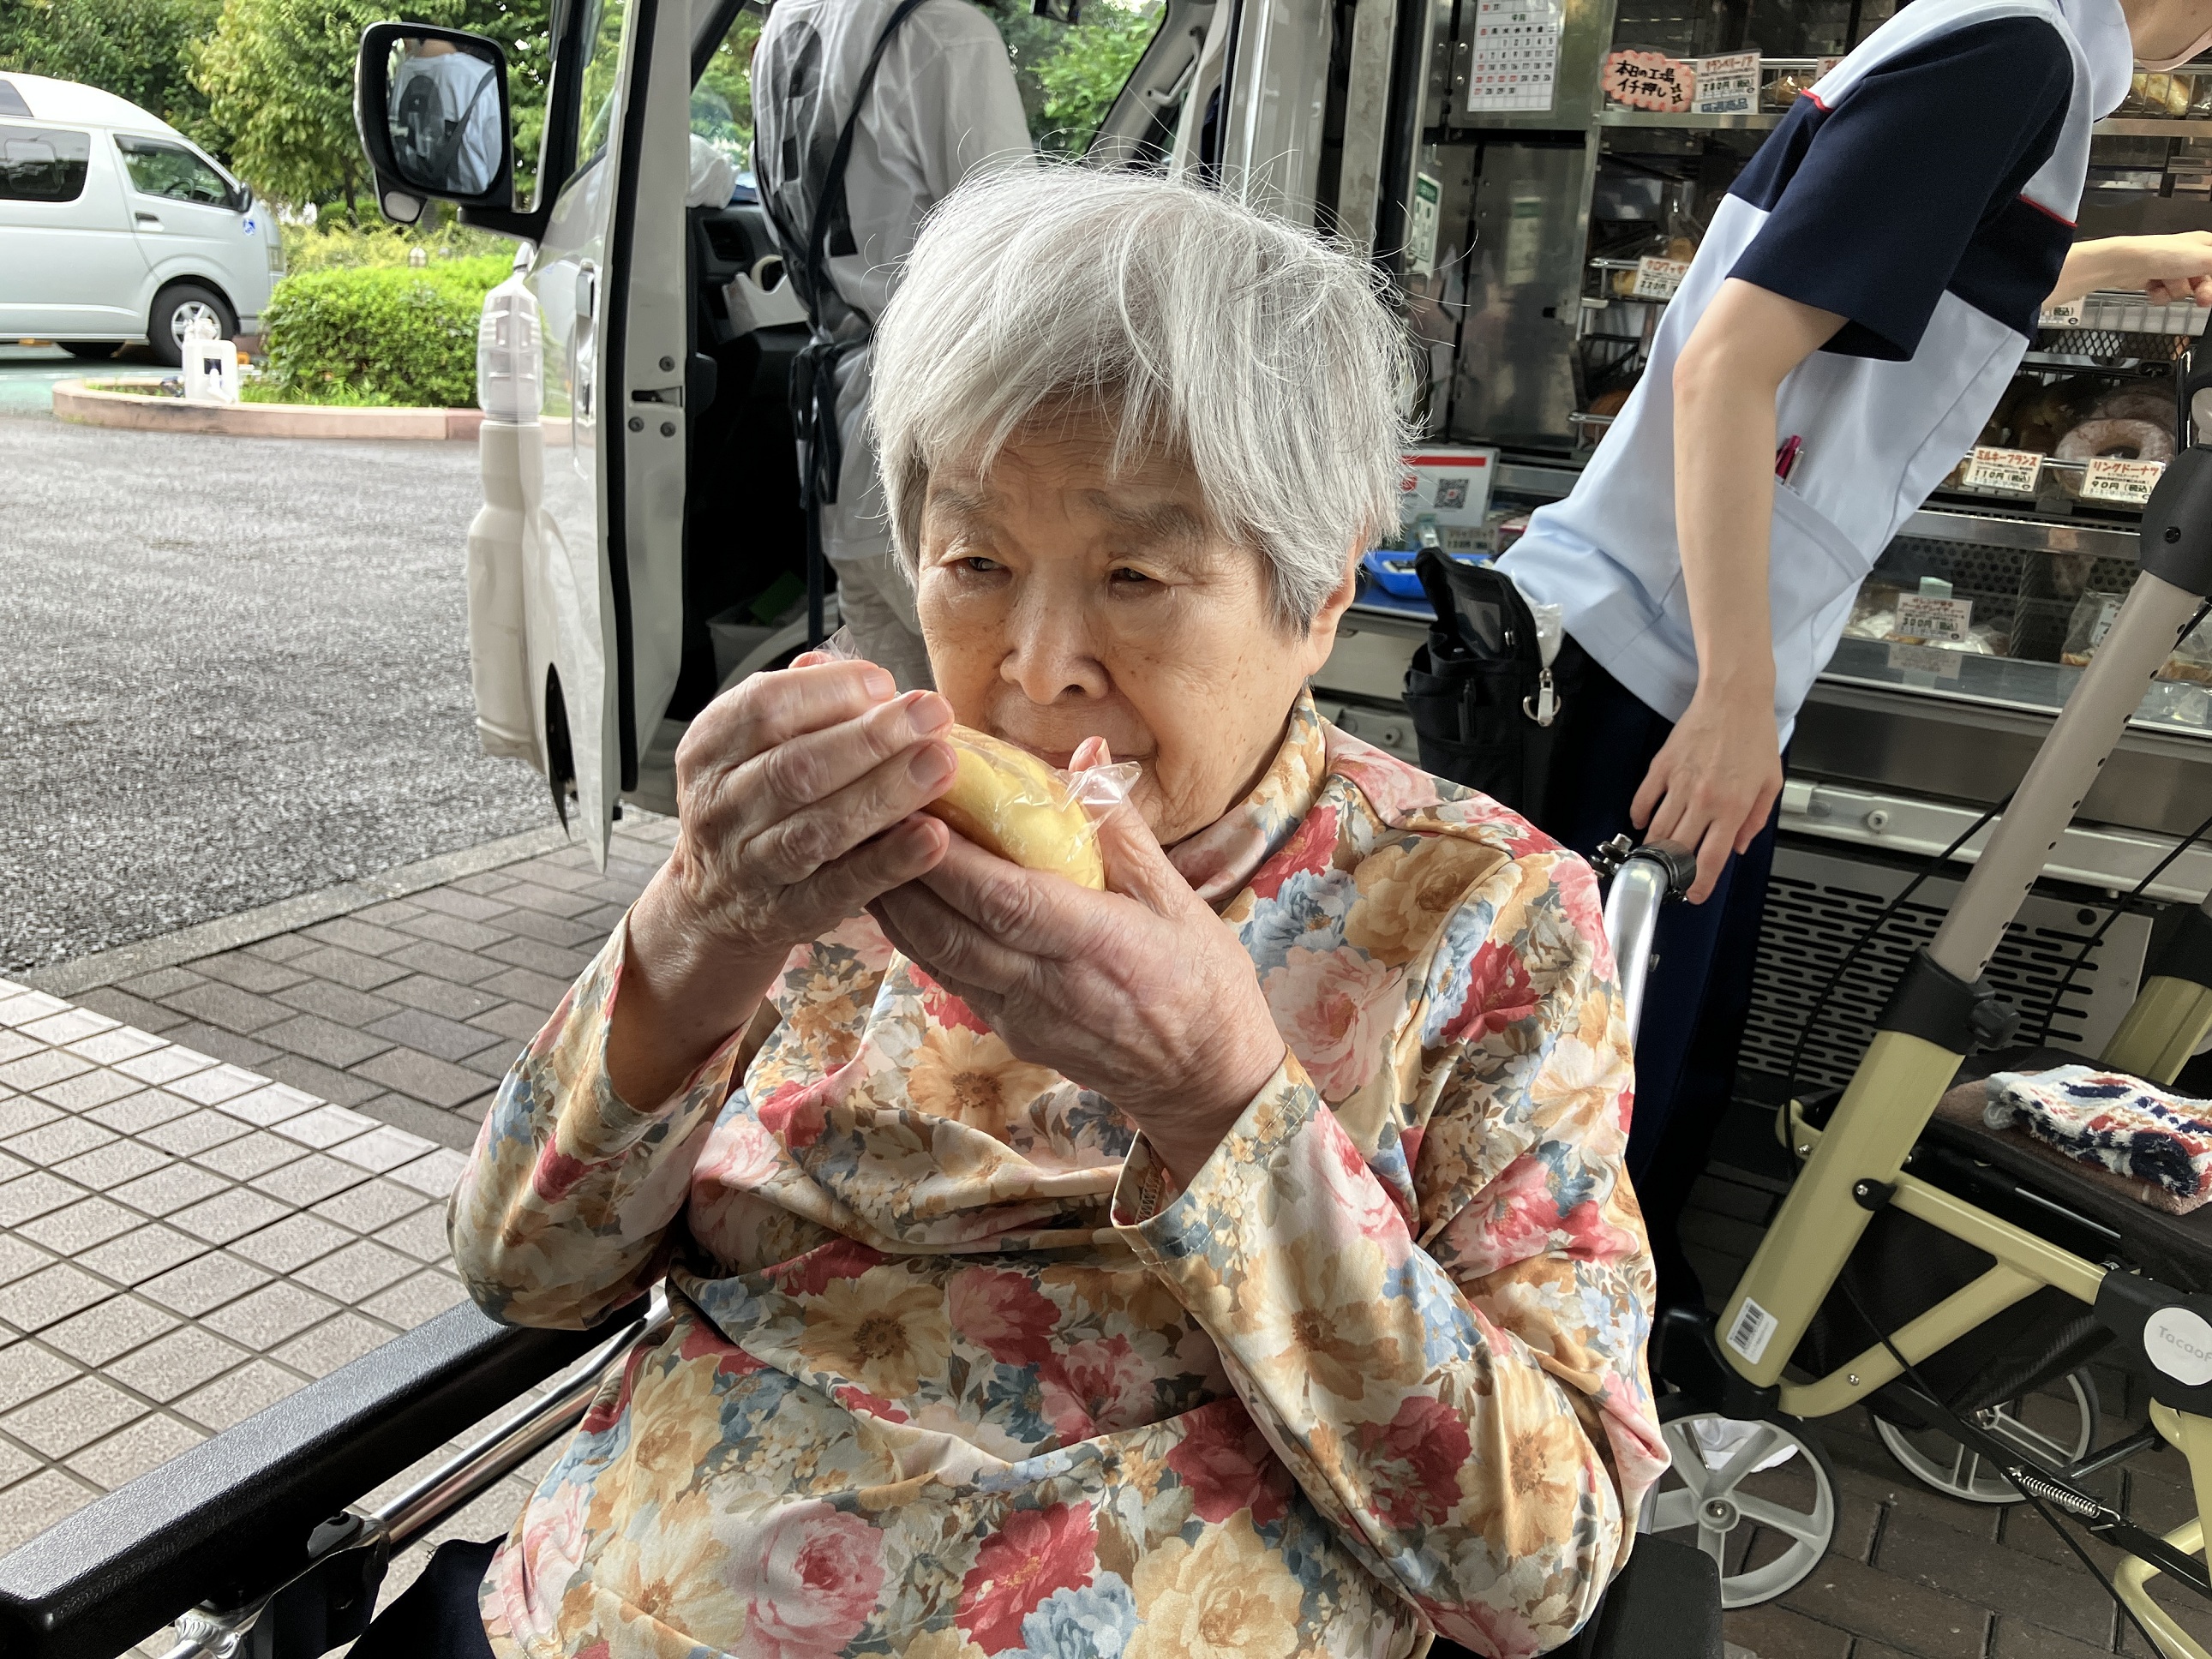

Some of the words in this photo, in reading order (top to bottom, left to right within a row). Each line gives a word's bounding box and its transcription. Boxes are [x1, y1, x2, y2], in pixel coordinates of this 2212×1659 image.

[1615, 60, 1675, 84] 本日の工場
[1617, 78, 1667, 98] イチ押し
[1646, 260, 1689, 273] クロワッサ
[1976, 450, 2037, 467] ミルキーフランス
[2094, 461, 2159, 476] リングドーナツ
[2091, 481, 2119, 490] 90円
